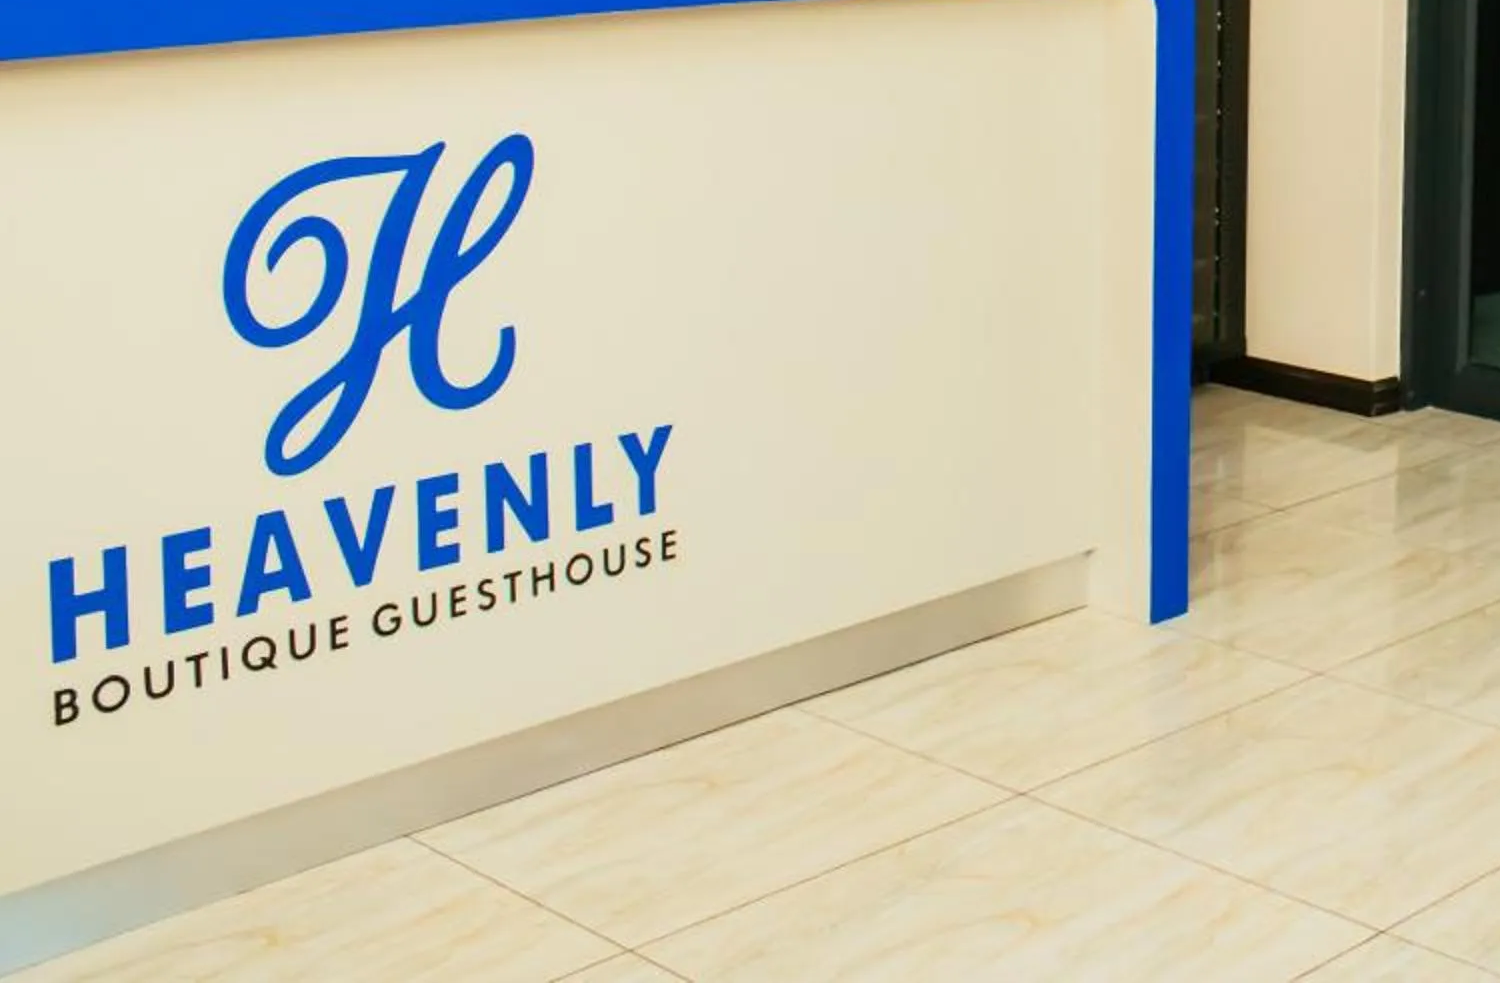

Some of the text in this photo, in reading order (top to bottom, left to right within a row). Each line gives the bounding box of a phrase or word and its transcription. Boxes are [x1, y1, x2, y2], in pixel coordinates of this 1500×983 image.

[222, 133, 535, 477] H
[47, 424, 674, 665] HEAVENLY
[53, 529, 679, 726] BOUTIQUE GUESTHOUSE
